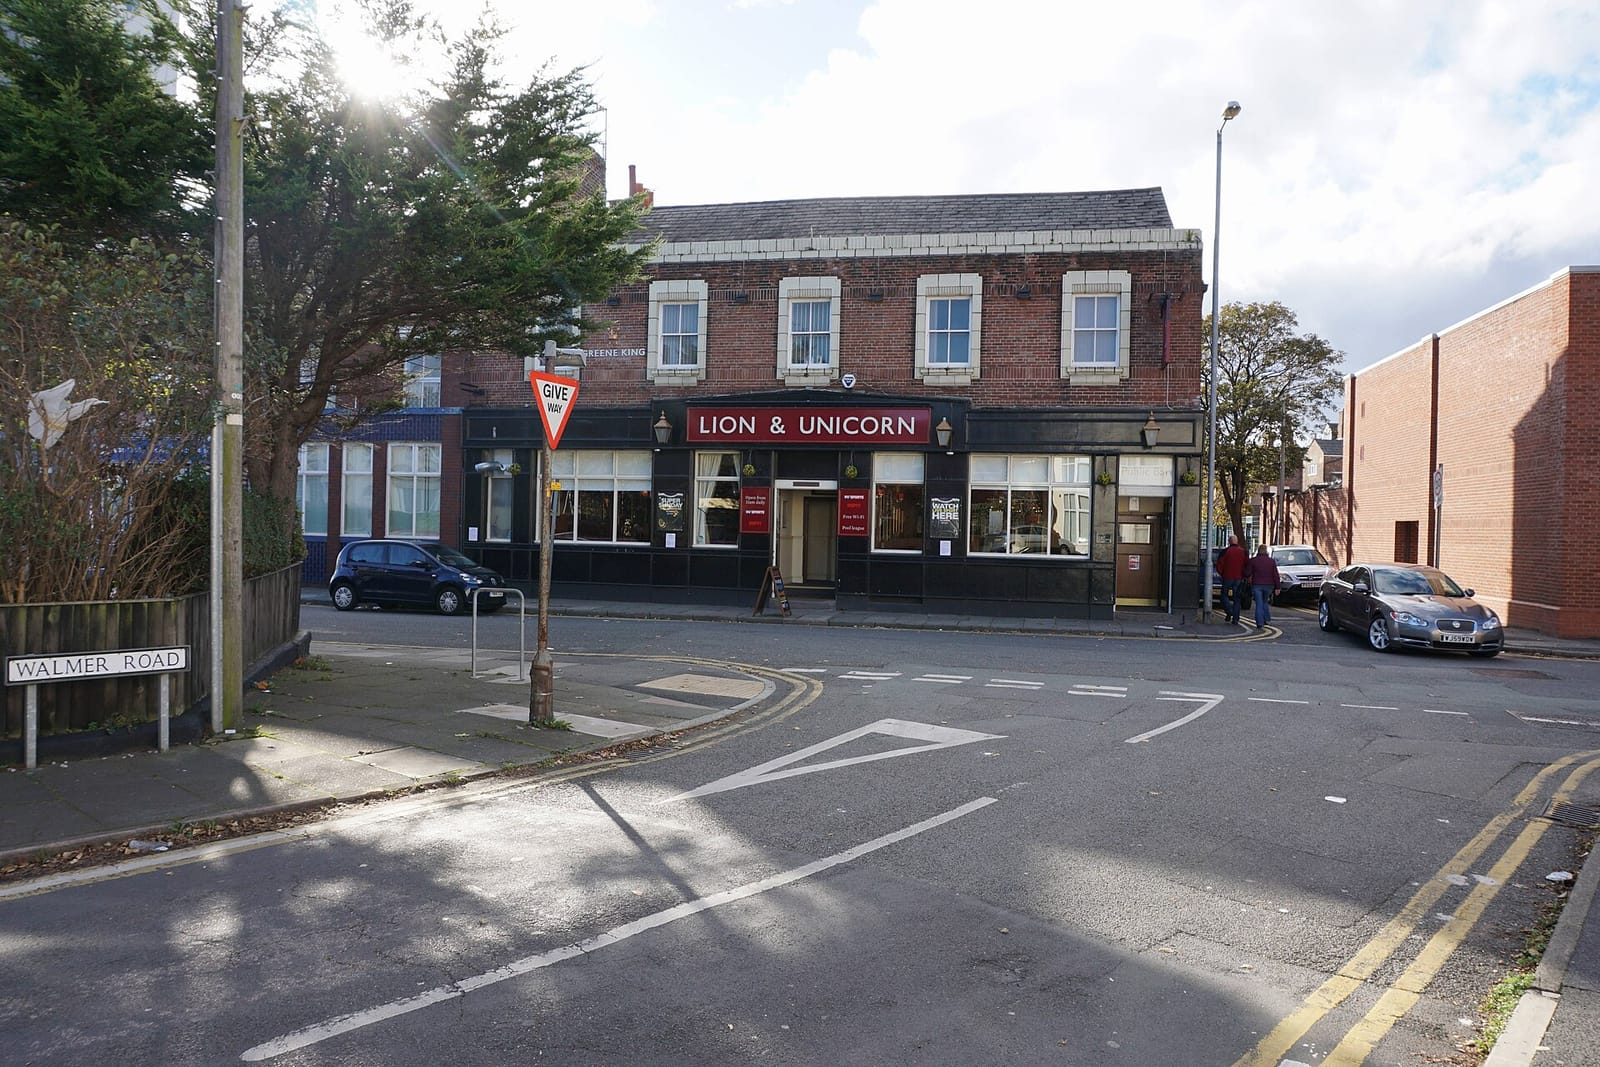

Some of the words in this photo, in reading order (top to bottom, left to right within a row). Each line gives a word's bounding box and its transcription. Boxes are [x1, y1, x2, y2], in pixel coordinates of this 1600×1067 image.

[583, 349, 618, 357] GREENE
[621, 348, 646, 356] KING
[543, 383, 569, 402] GIVE
[547, 402, 563, 414] WAY
[700, 416, 756, 434] LION
[770, 416, 786, 434] &
[799, 416, 916, 435] UNICORN
[932, 512, 959, 520] HERE
[16, 657, 109, 677] WALMER
[124, 652, 180, 671] ROAD
